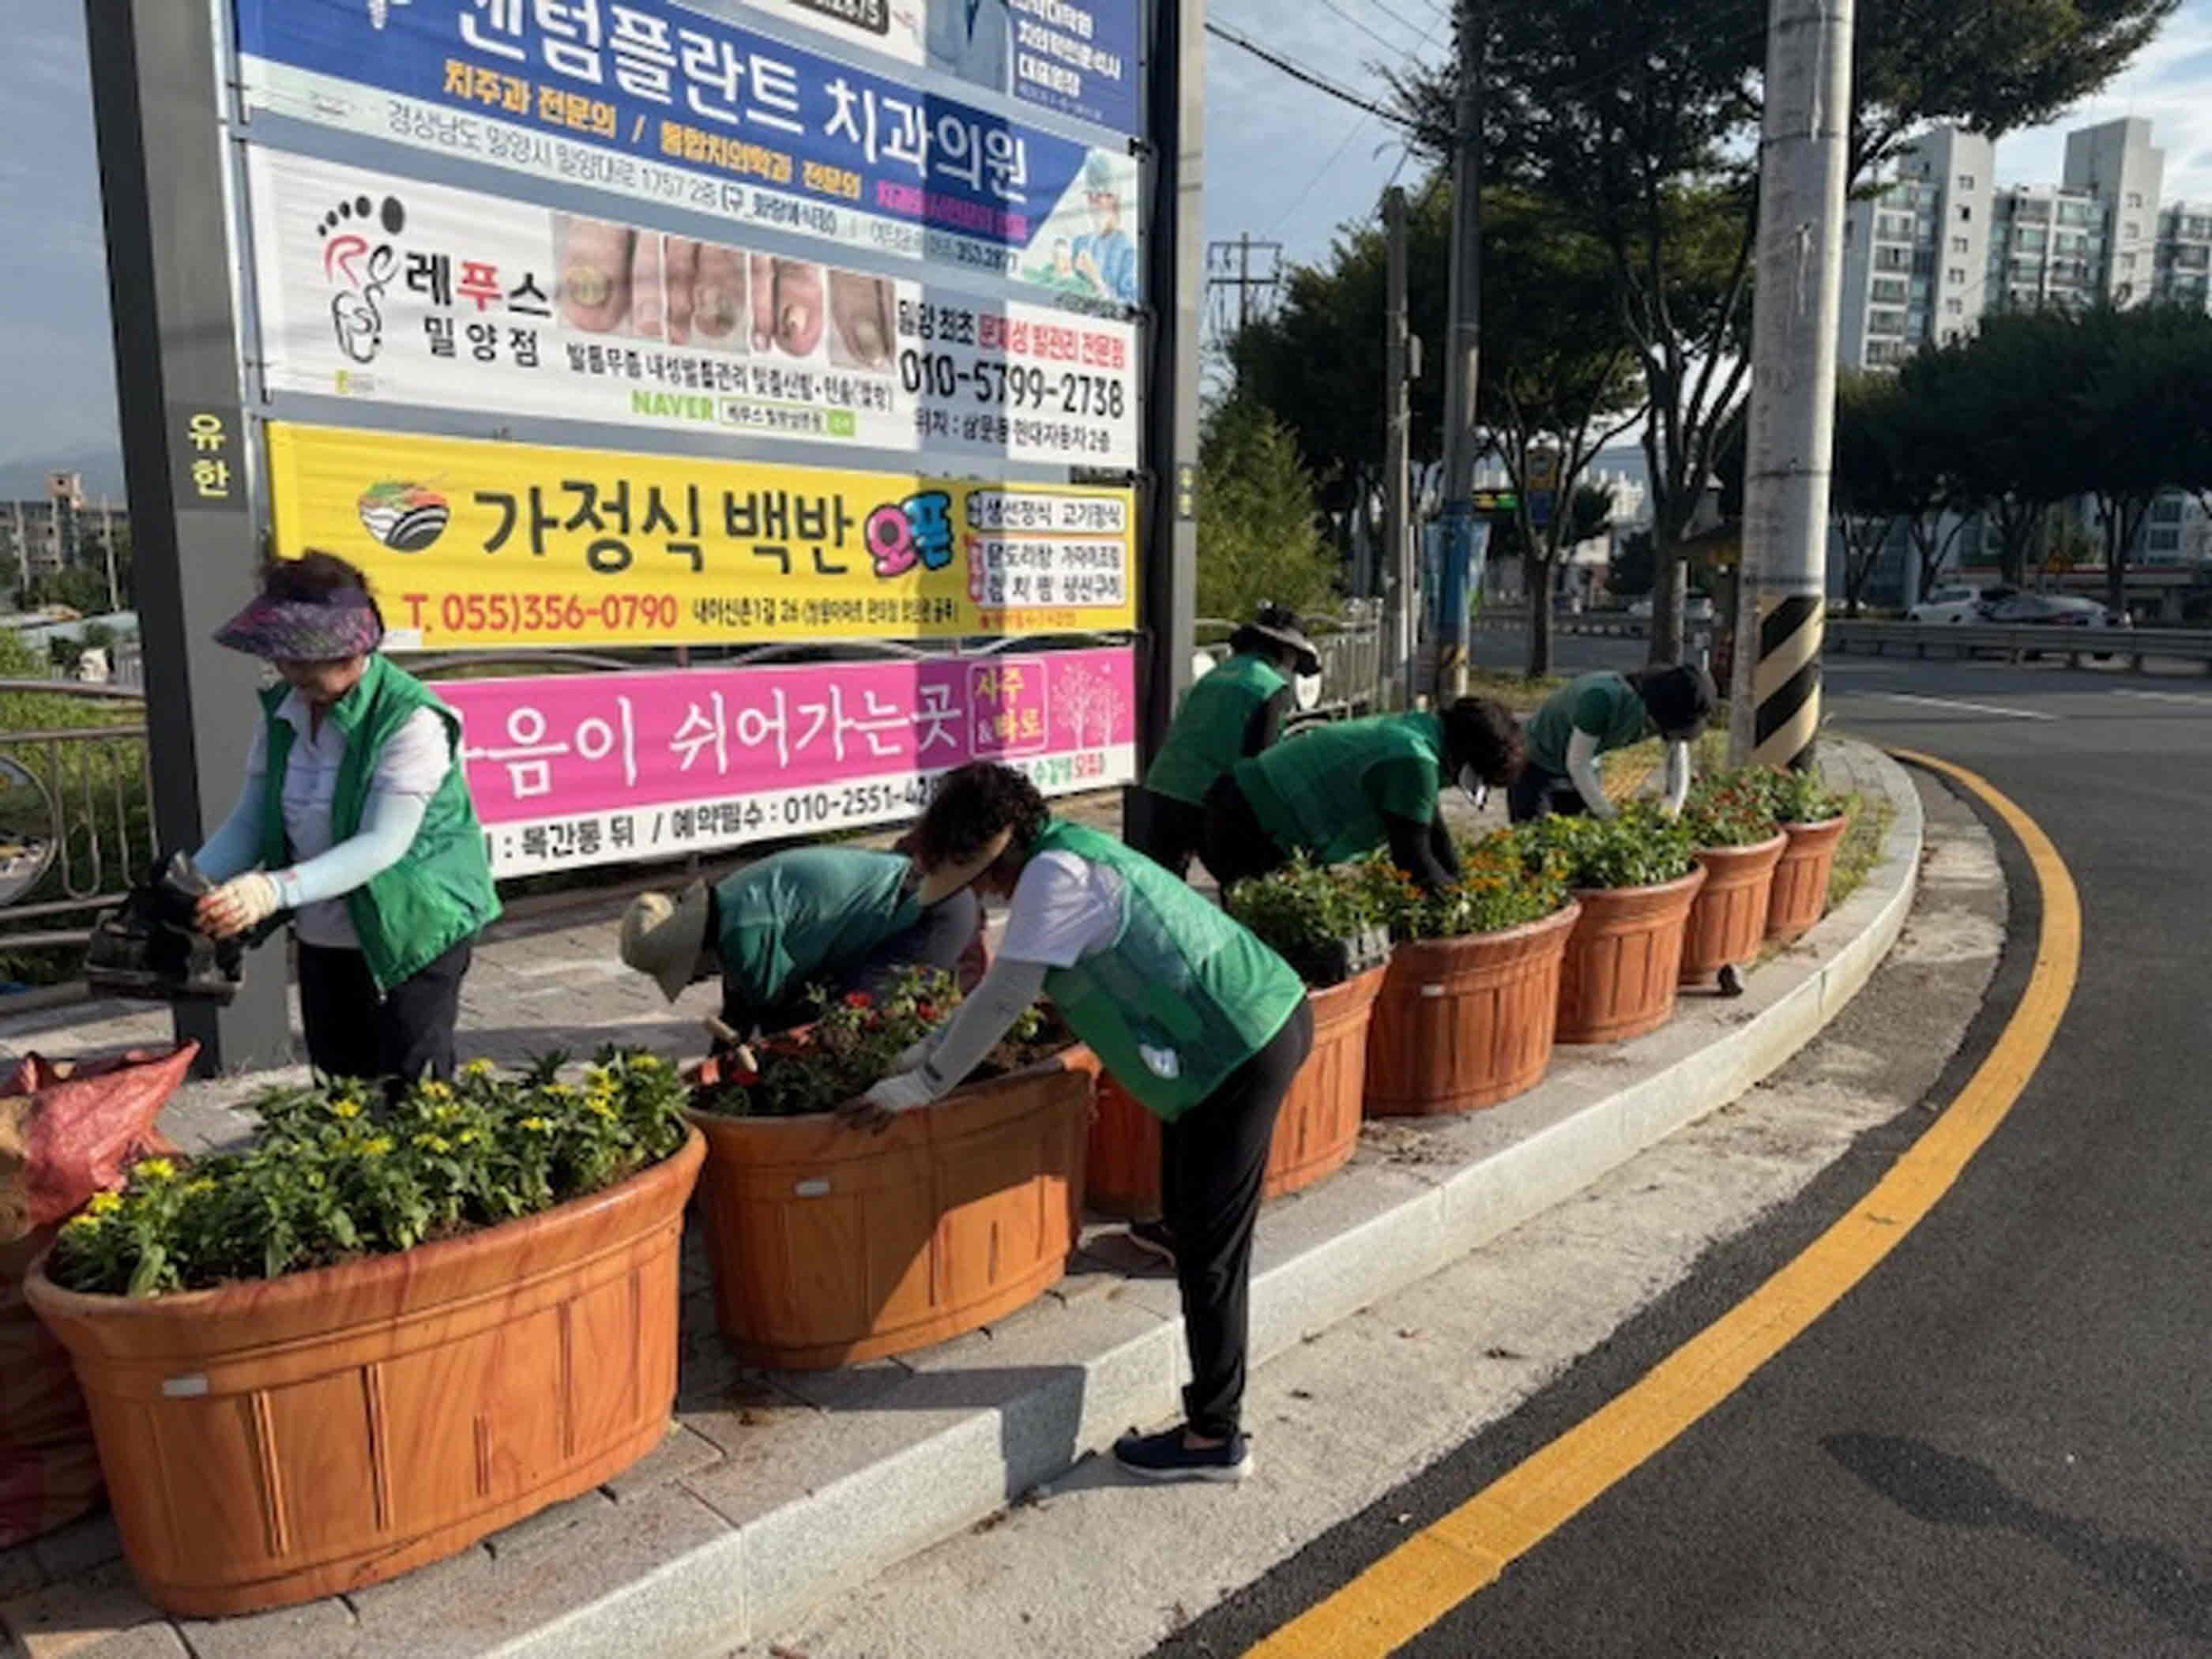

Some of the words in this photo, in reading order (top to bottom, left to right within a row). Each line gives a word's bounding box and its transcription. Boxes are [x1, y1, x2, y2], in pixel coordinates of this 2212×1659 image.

[388, 99, 481, 152] 경상남도
[486, 123, 551, 167] 밀양시
[556, 144, 635, 188] 밀양대로
[443, 58, 531, 115] 치주과
[539, 84, 616, 139] 전문의
[802, 160, 862, 200] 전문의
[823, 77, 1027, 204] 치과의원
[405, 252, 552, 318] 레푸스
[424, 316, 539, 367] 밀양점
[632, 389, 713, 420] NAVER
[900, 348, 1123, 419] 010-5799-2738
[187, 414, 230, 496] 유한
[474, 479, 705, 575] 가정식
[722, 488, 855, 576] 백반
[442, 592, 678, 634] 055)356-0790
[463, 693, 638, 800] 음이
[611, 814, 635, 848] 뒤
